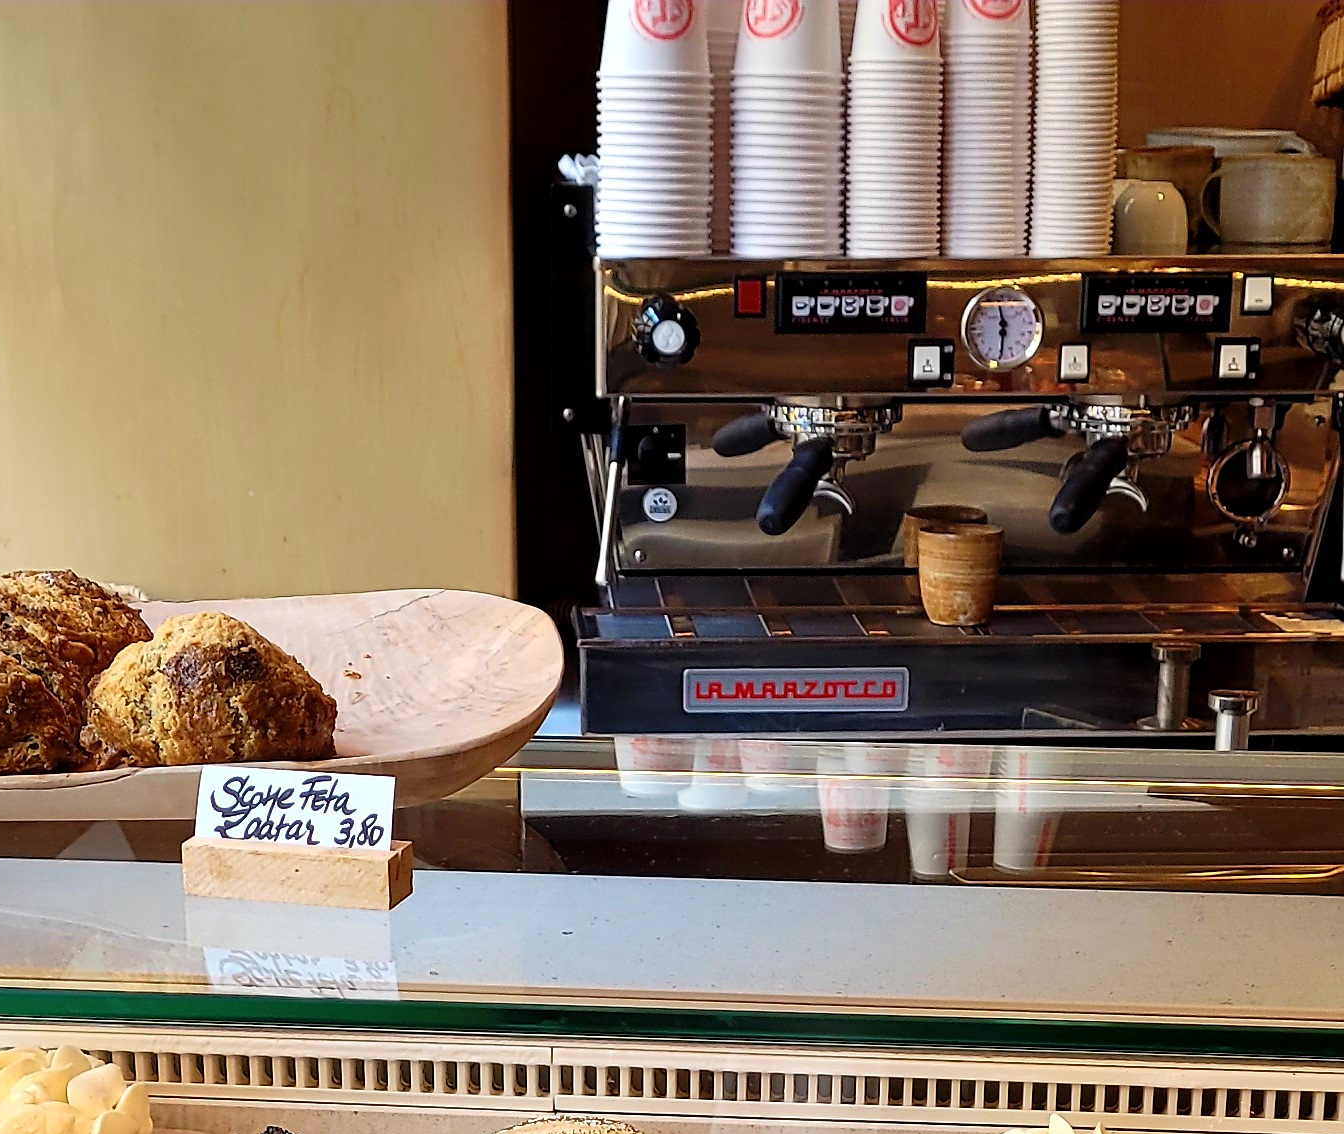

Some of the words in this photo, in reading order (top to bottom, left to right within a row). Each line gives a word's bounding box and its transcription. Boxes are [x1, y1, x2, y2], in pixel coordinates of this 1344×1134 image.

[695, 681, 724, 699] LA
[299, 775, 358, 815] Feta
[333, 812, 385, 848] 3,80
